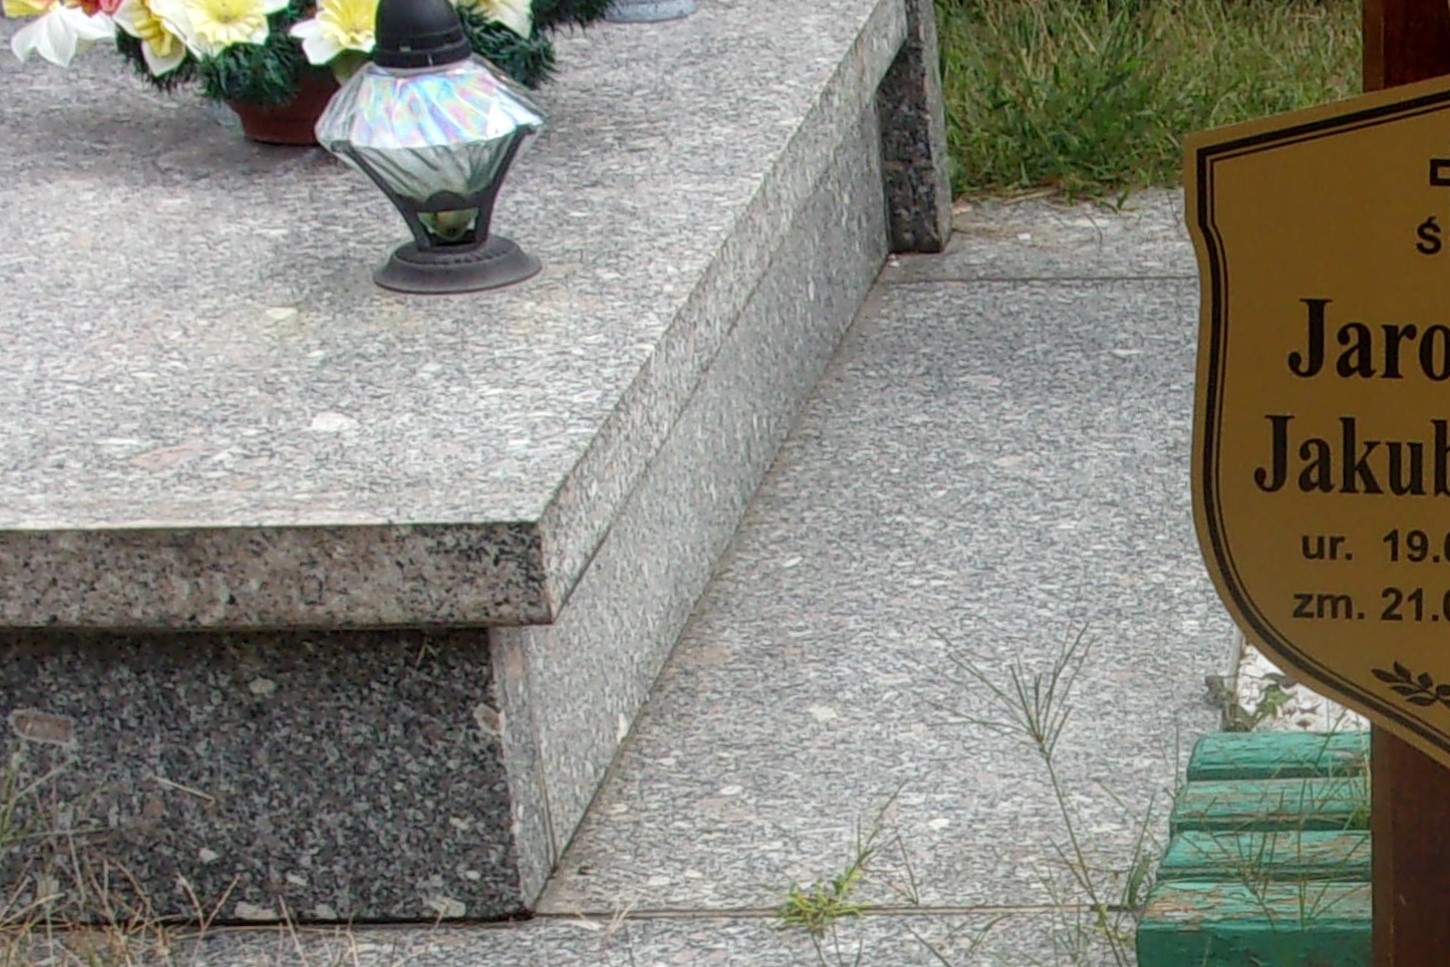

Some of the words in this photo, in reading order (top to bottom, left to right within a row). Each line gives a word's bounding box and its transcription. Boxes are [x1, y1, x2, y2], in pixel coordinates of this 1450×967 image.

[1415, 215, 1443, 256] Ś
[1301, 534, 1353, 563] ur.
[1292, 593, 1365, 621] zm.
